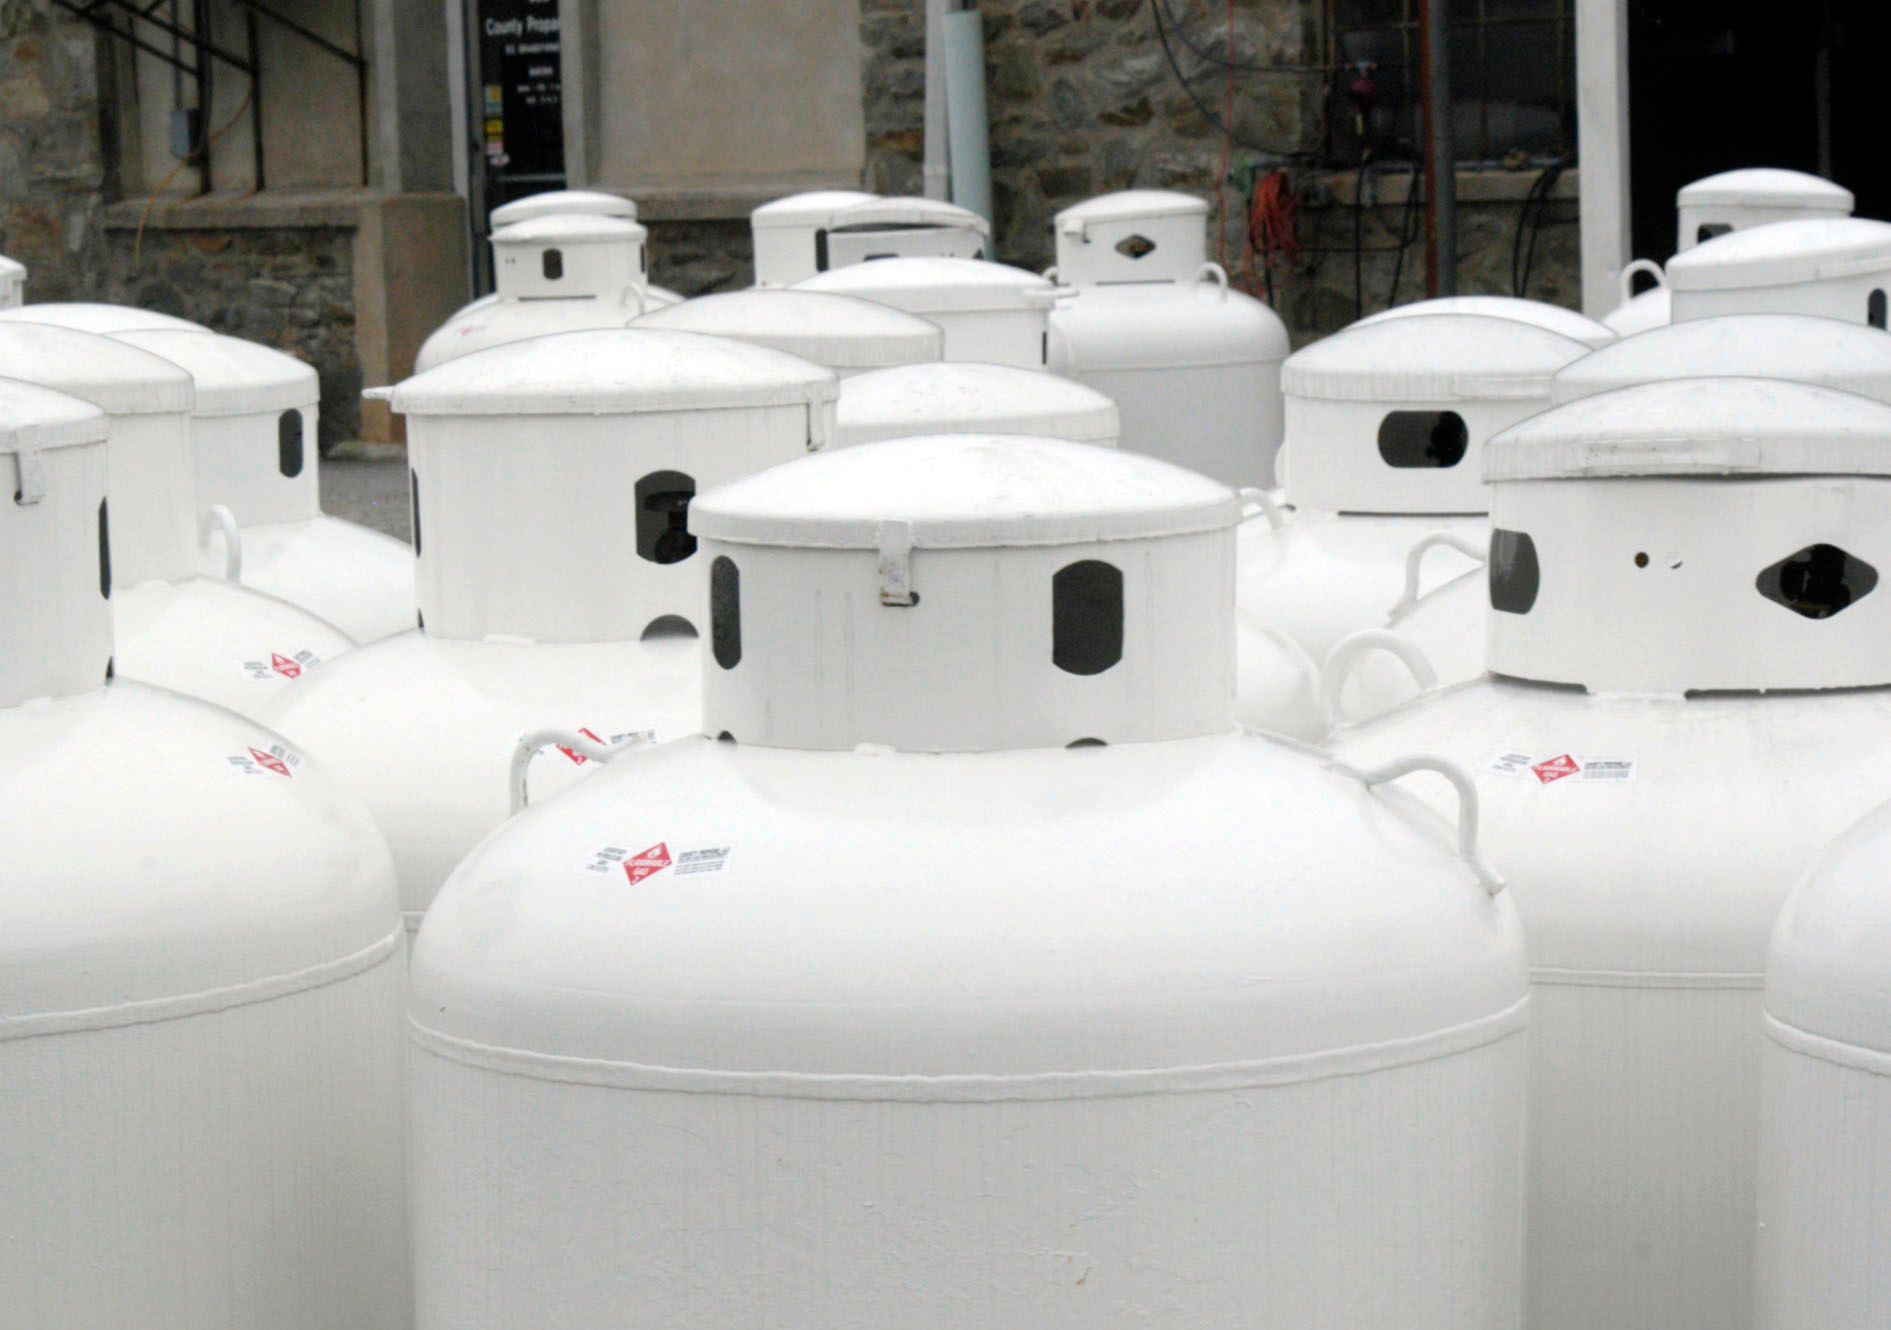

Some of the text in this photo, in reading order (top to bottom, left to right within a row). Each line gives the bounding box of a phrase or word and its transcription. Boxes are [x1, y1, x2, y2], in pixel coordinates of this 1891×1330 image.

[485, 17, 523, 37] County
[625, 858, 671, 867] FLAMMABLE
[632, 867, 649, 875] GAS
